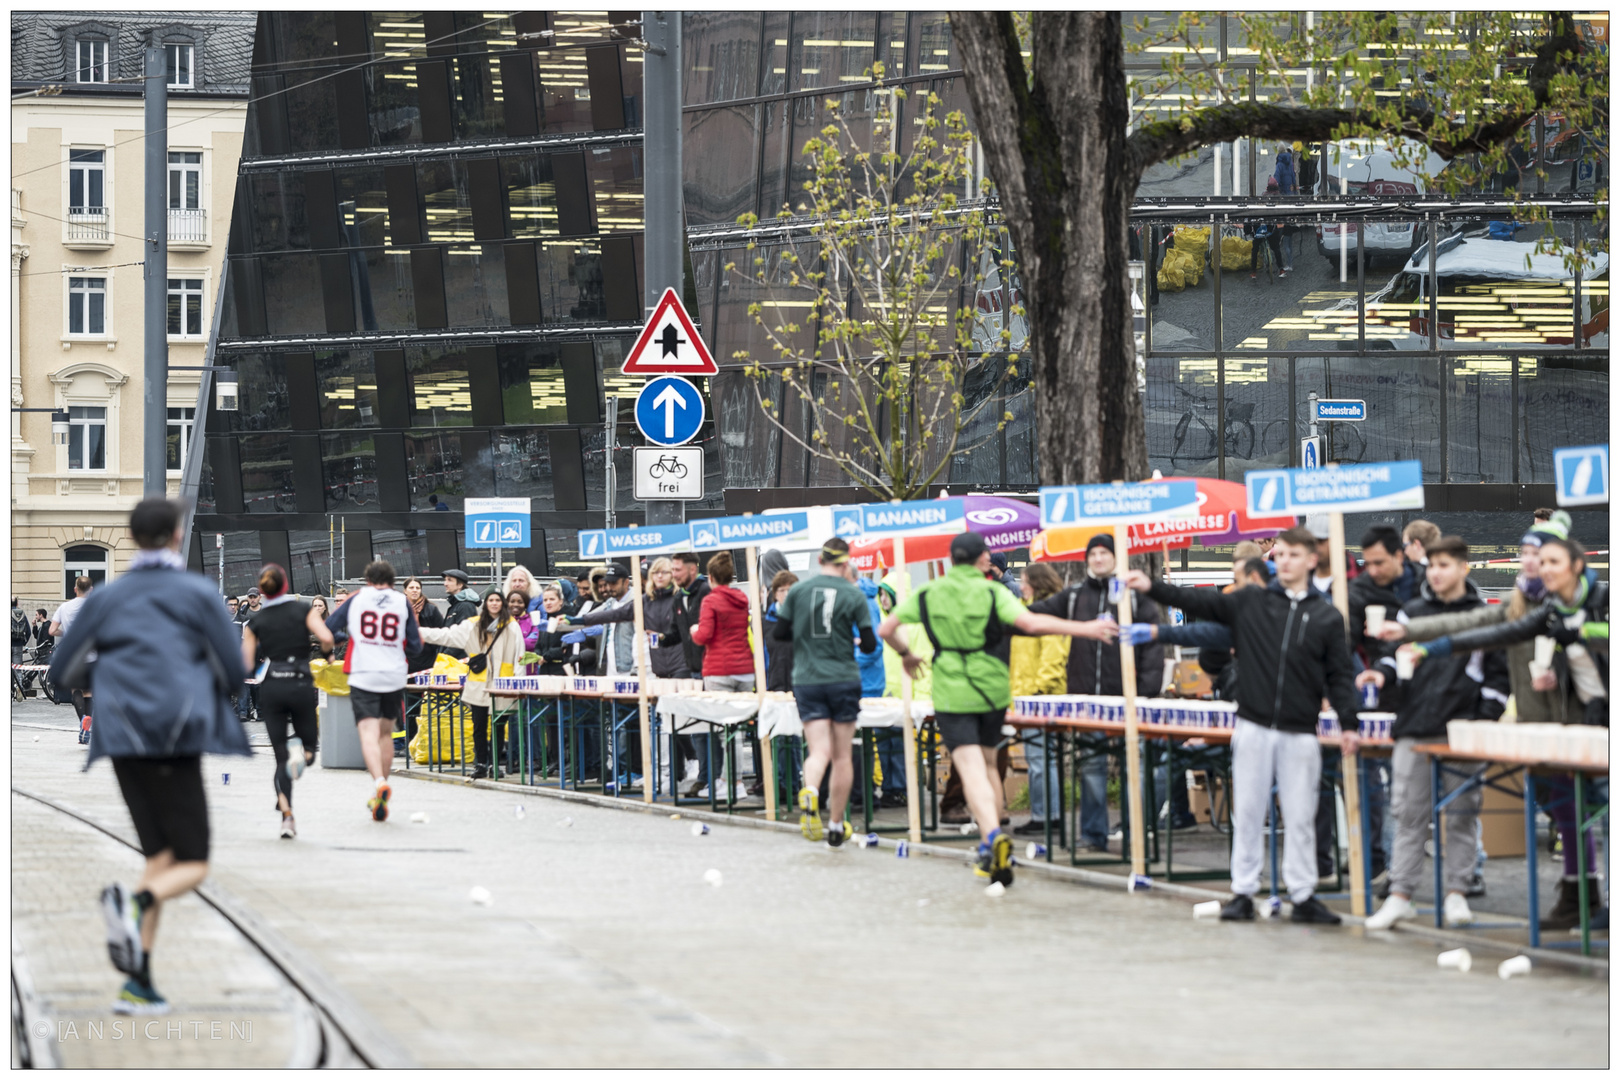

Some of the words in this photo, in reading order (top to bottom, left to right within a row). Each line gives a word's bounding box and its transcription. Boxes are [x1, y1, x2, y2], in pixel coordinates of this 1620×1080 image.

[1320, 405, 1361, 415] Sedanstraße
[658, 482, 679, 493] frei
[1295, 483, 1371, 502] GETRÄNKE
[1083, 499, 1152, 515] GETRÄNKE
[866, 508, 946, 527] BANANEN
[1143, 514, 1224, 535] LANGNESE
[722, 519, 794, 539] BANANEN
[984, 529, 1039, 547] ANGNESE
[609, 532, 663, 547] WASSER
[360, 610, 400, 641] 66
